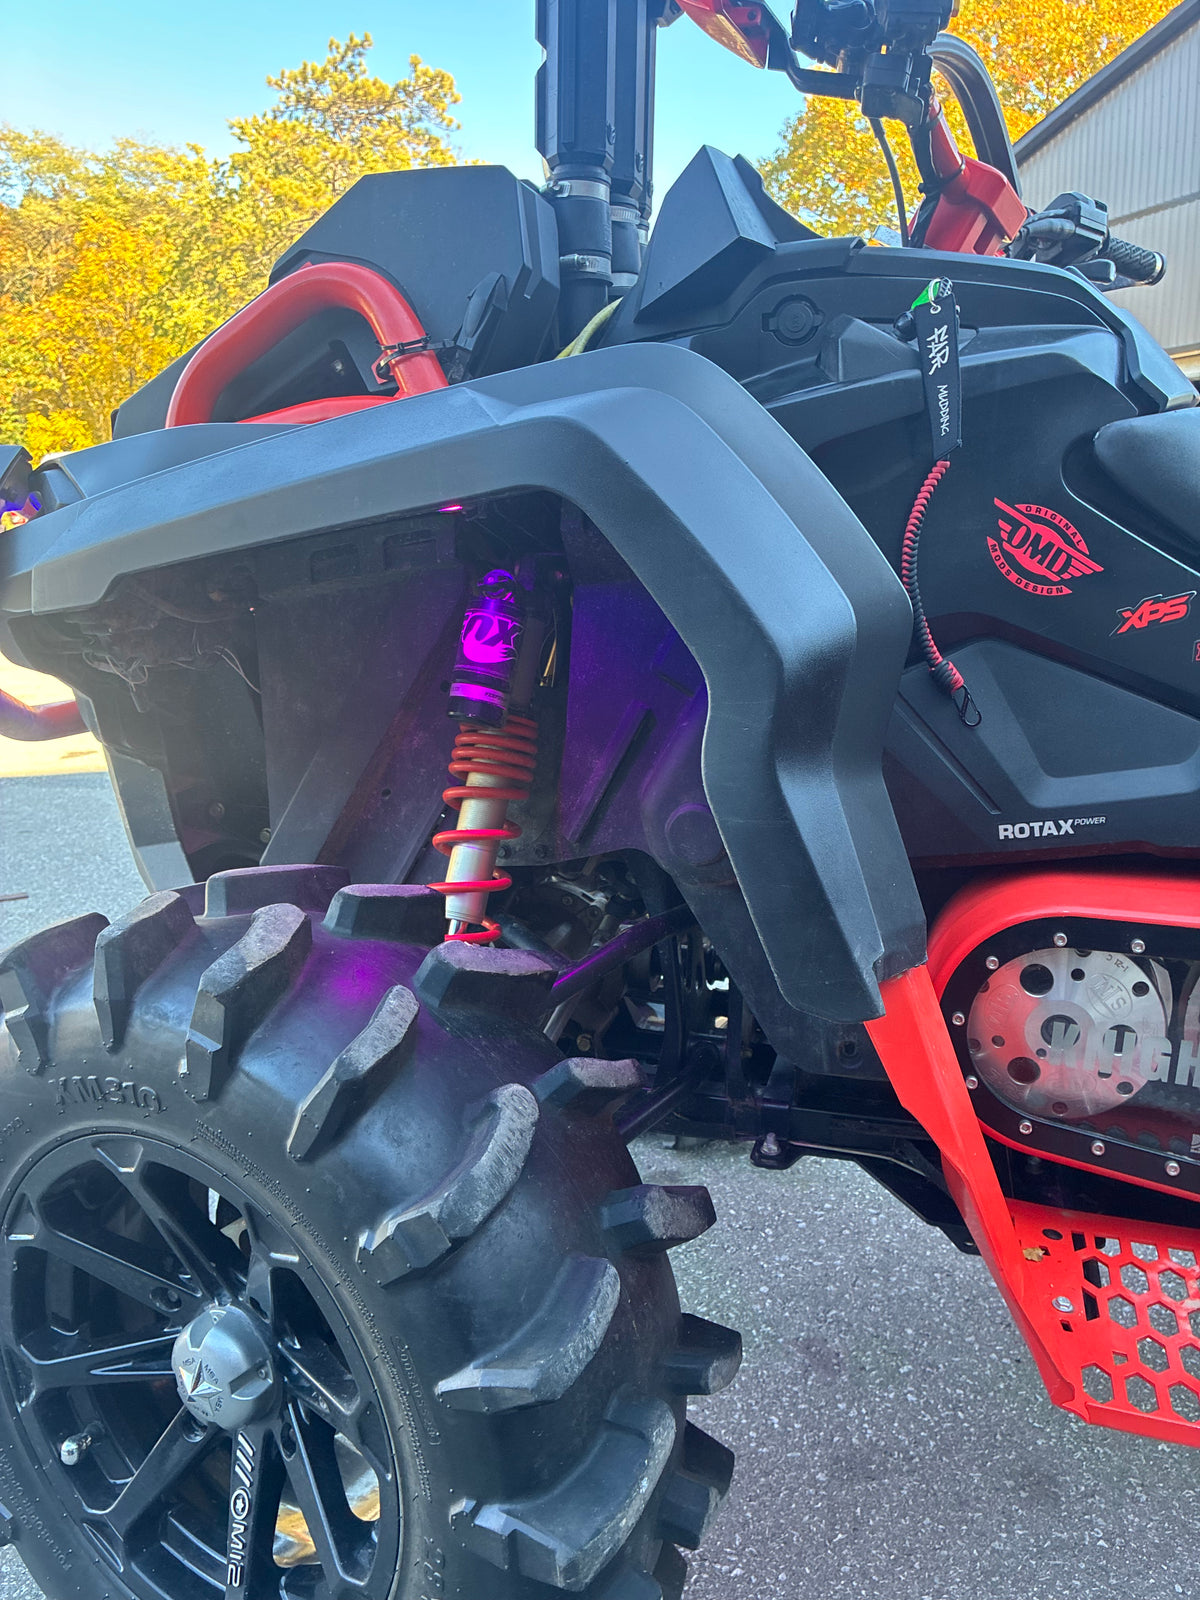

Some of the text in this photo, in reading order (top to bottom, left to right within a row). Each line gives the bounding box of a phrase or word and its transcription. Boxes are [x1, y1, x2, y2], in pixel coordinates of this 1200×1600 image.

[936, 384, 950, 437] MUDDING
[1024, 505, 1083, 547] ORIGINAL
[988, 543, 1064, 595] MODS DESIGN
[1117, 595, 1190, 633] XPS
[998, 816, 1106, 840] ROTAX POWER
